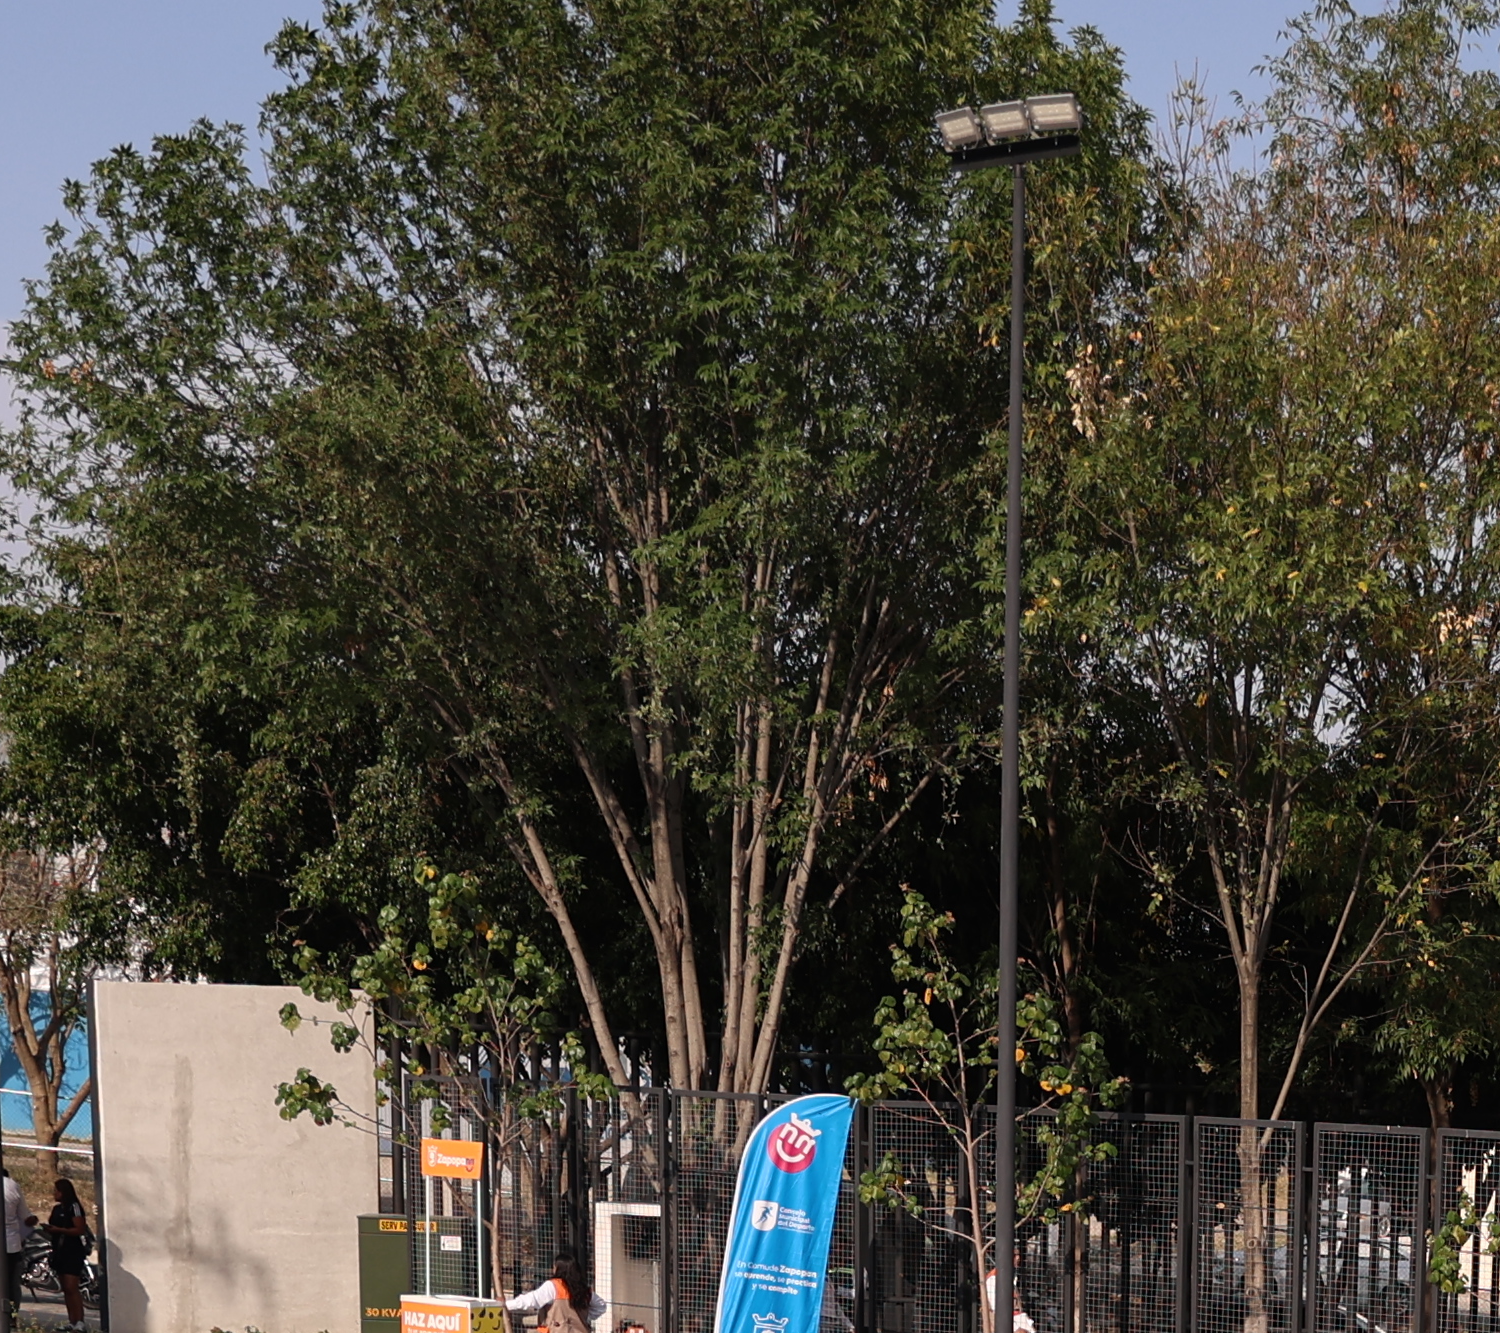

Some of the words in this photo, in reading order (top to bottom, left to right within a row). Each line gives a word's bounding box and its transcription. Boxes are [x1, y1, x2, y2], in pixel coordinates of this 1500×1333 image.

[780, 1265, 817, 1278] Zapopan
[404, 1311, 425, 1328] HAZ
[427, 1312, 461, 1331] AQUÍ
